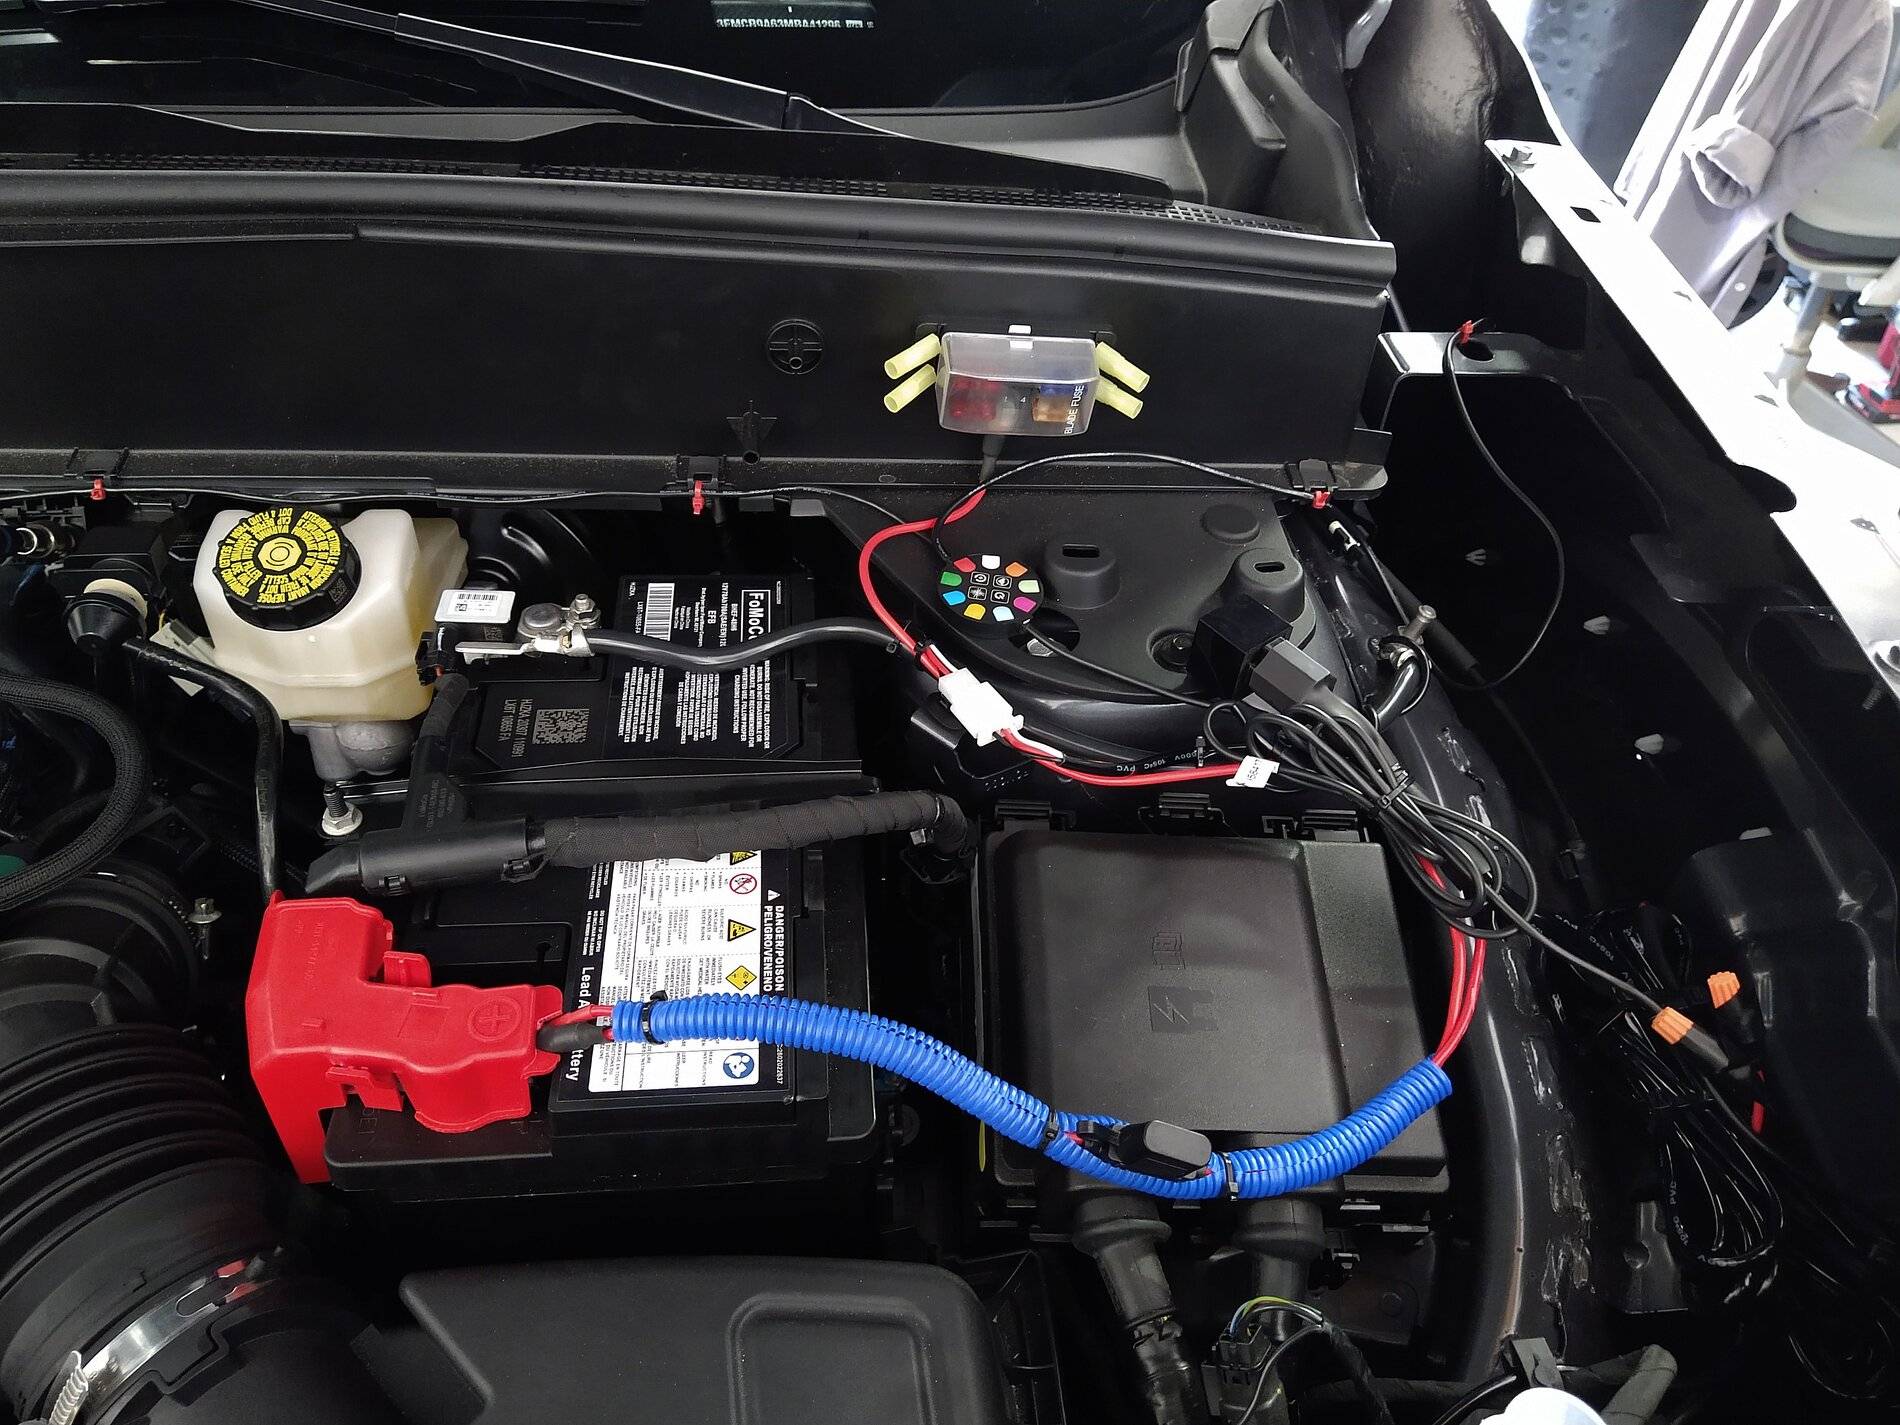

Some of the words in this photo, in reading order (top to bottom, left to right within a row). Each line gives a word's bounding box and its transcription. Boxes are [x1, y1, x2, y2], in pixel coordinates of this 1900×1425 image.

[1064, 408, 1078, 434] BLADE
[1071, 385, 1084, 407] FUSE
[248, 512, 269, 525] FLUID
[278, 508, 292, 517] DOT
[267, 585, 278, 593] DOT
[708, 610, 716, 624] EFB
[498, 733, 511, 741] FA
[764, 906, 773, 991] PELIGRO/VENENO
[775, 906, 784, 991] DANGER/POISON
[580, 967, 594, 997] Lead
[566, 1050, 584, 1081] ttery
